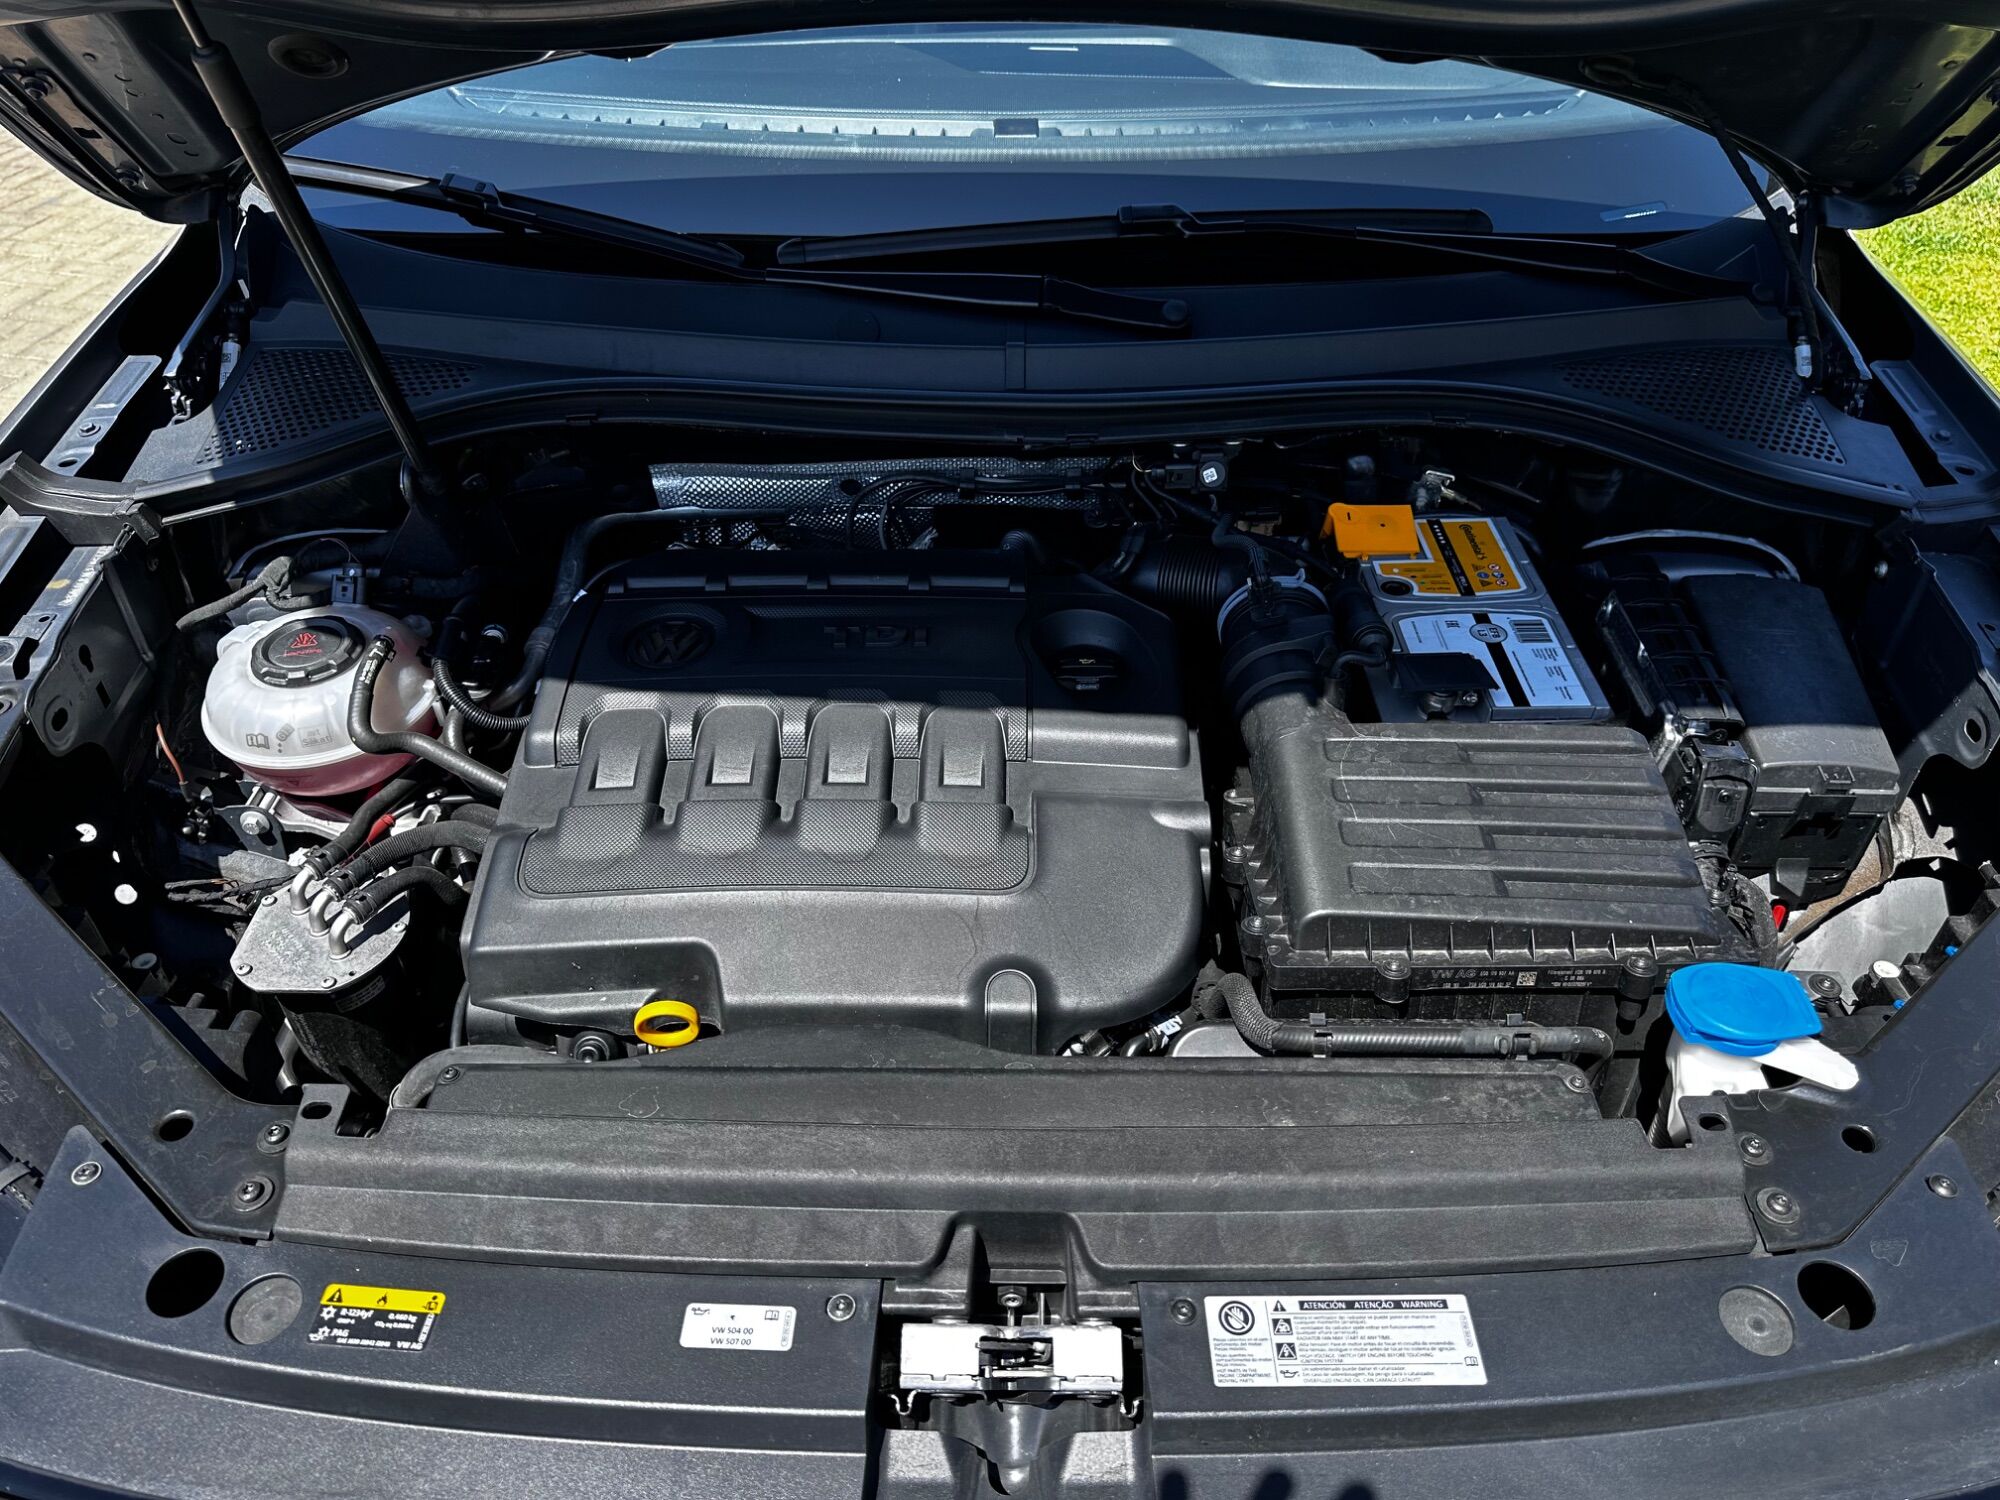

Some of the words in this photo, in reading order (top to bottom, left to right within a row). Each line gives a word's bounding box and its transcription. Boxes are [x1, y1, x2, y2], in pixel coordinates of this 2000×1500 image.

[824, 626, 928, 648] TDI
[1489, 627, 1501, 639] EFB
[1431, 969, 1454, 978] VW
[1455, 969, 1477, 978] AG
[1303, 1300, 1346, 1309] ATENCIÓN
[1354, 1300, 1394, 1309] ATENÇÃO
[1400, 1300, 1444, 1309] WARNING
[330, 1328, 349, 1337] PAG
